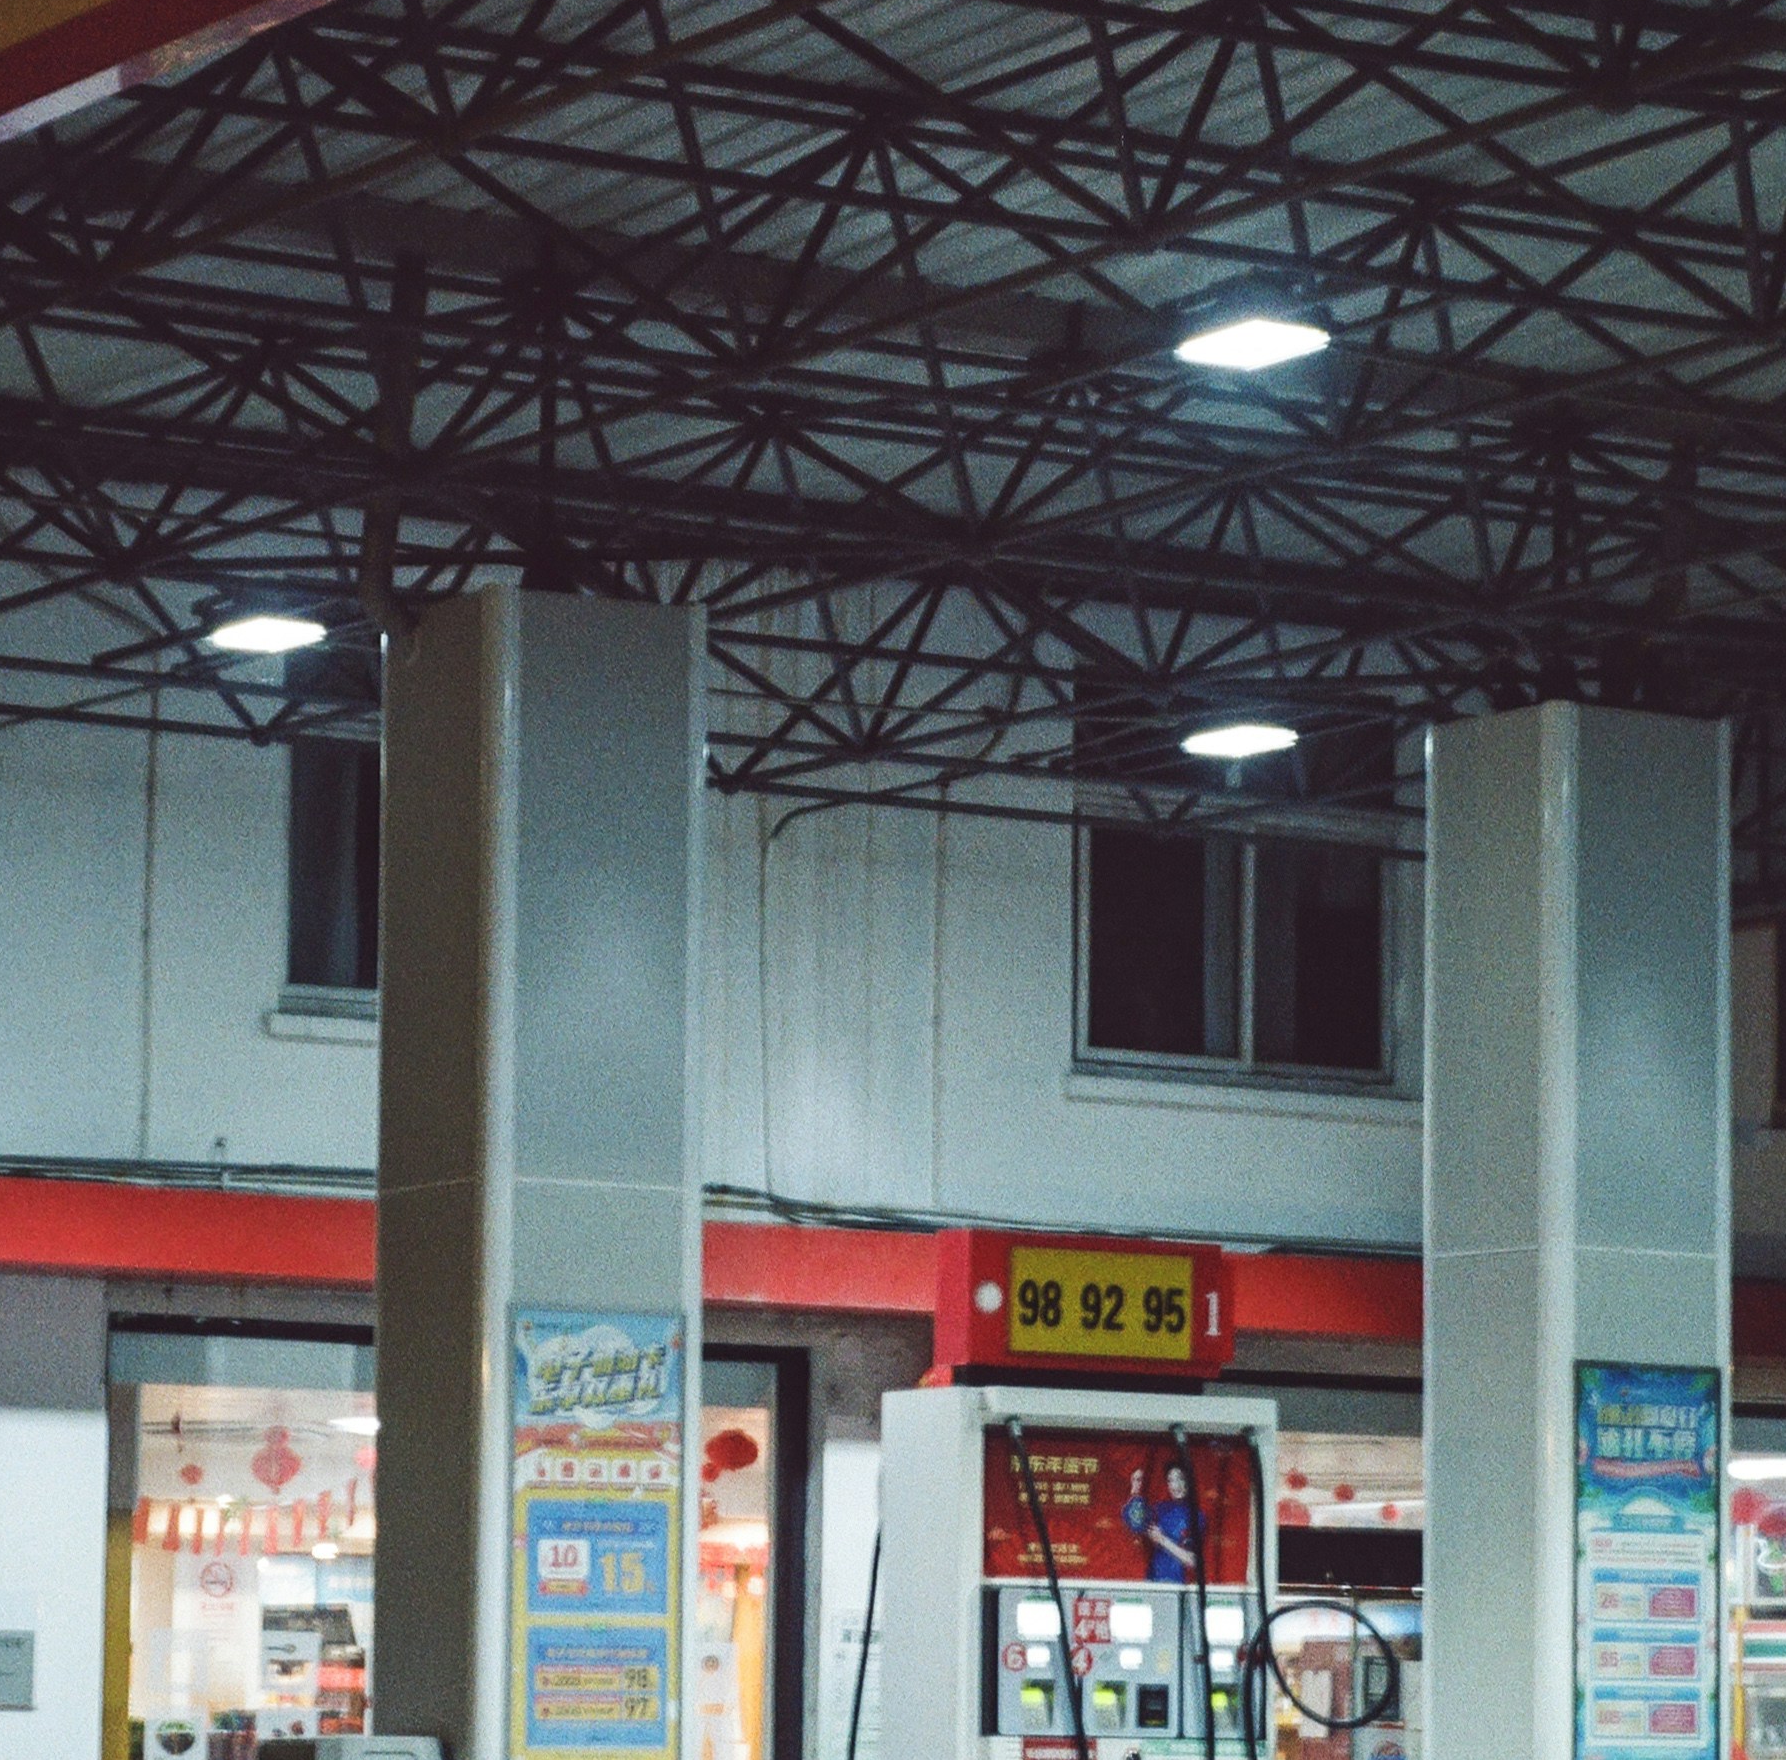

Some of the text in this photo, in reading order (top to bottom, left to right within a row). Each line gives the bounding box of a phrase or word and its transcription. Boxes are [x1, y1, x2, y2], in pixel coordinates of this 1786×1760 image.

[1018, 1280, 1185, 1333] 98 92 95
[1205, 1291, 1221, 1336] 1
[550, 1545, 577, 1567] 10
[599, 1552, 645, 1594] 15
[1007, 1645, 1022, 1669] 6
[1072, 1648, 1086, 1674] 4
